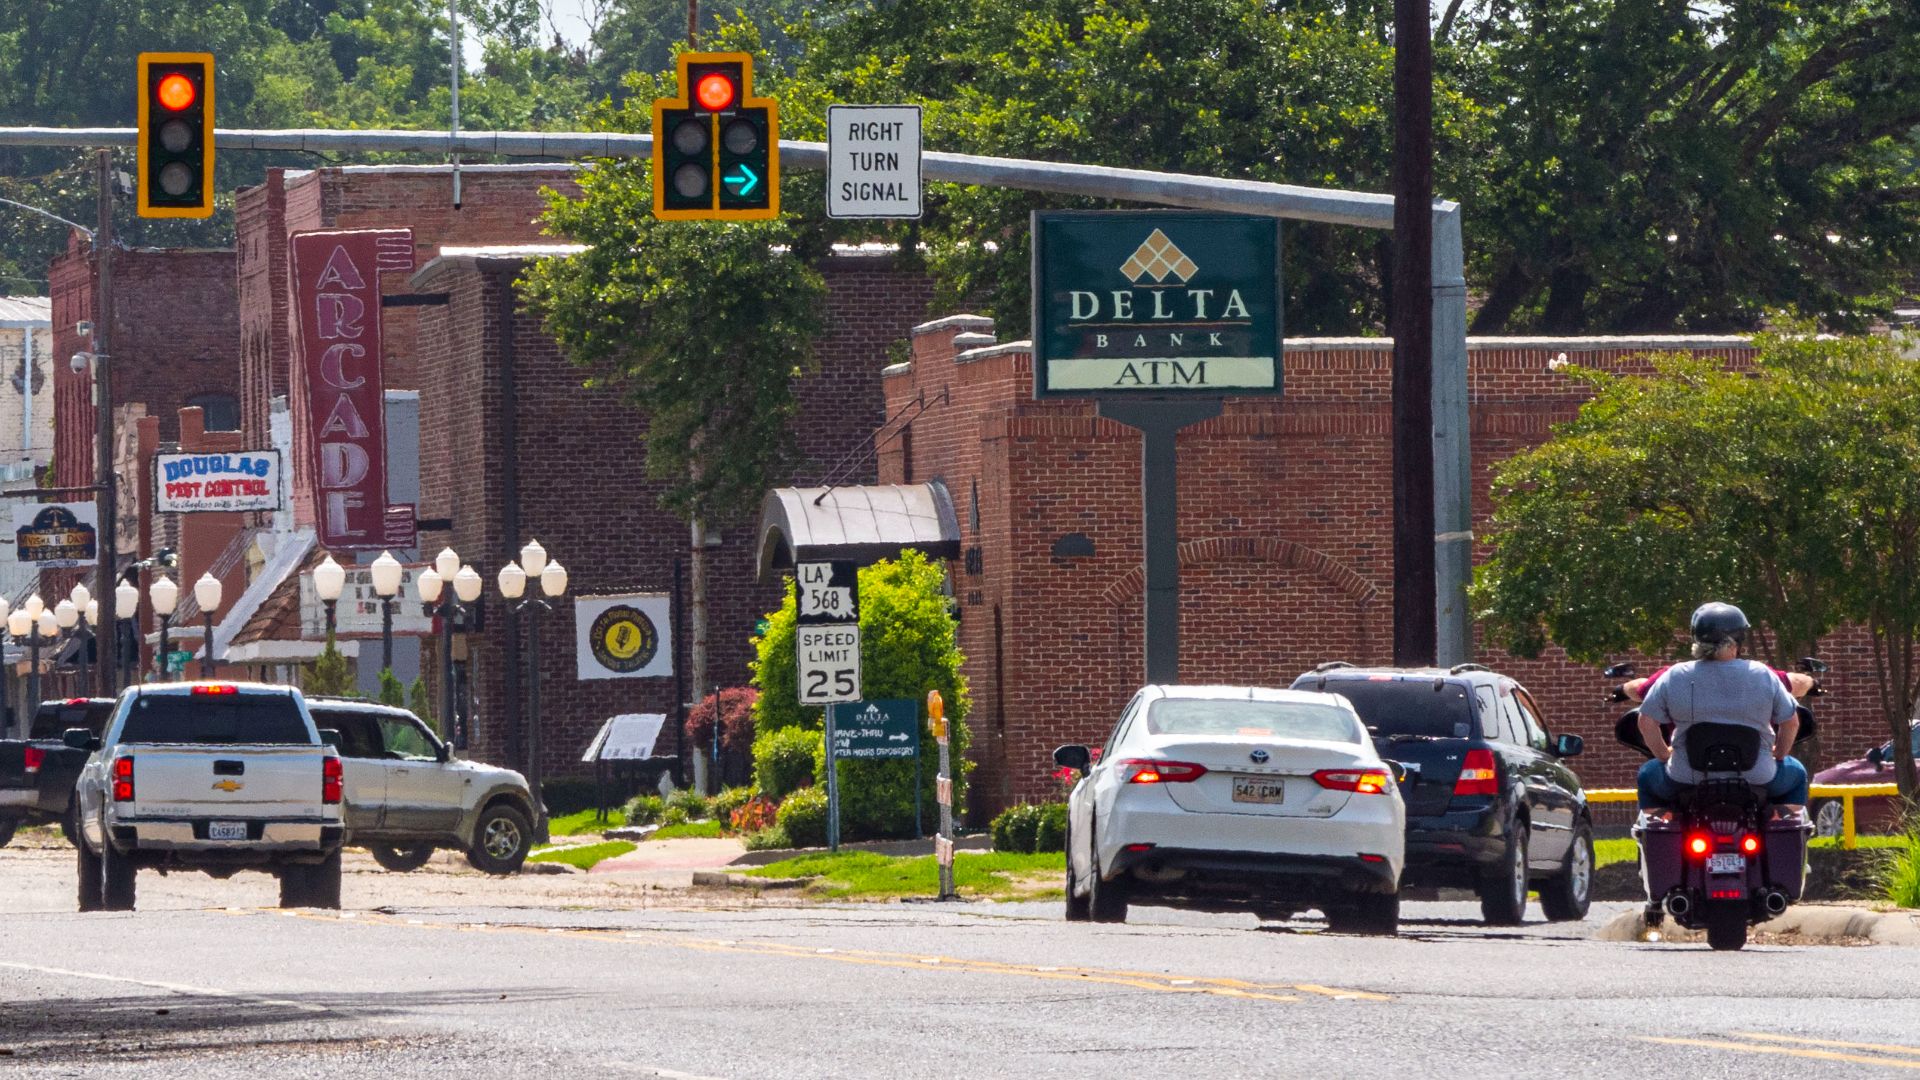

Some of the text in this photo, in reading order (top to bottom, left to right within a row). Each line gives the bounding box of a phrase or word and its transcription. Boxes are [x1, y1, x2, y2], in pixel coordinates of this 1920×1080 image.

[848, 122, 904, 141] RIGHT
[849, 152, 899, 171] TURN
[841, 182, 909, 201] SIGNAL
[1068, 289, 1251, 320] DELTA
[1096, 333, 1223, 348] BANK
[1113, 360, 1209, 386] ATM
[315, 244, 370, 537] ARCADE
[163, 455, 271, 481] DOUGLAS
[165, 479, 271, 499] PEST CONTROL
[804, 566, 823, 583] LA
[811, 589, 839, 610] 568
[803, 632, 855, 647] SPEED
[808, 650, 850, 663] LIMIT
[806, 669, 855, 698] 25
[1236, 784, 1255, 796] 542
